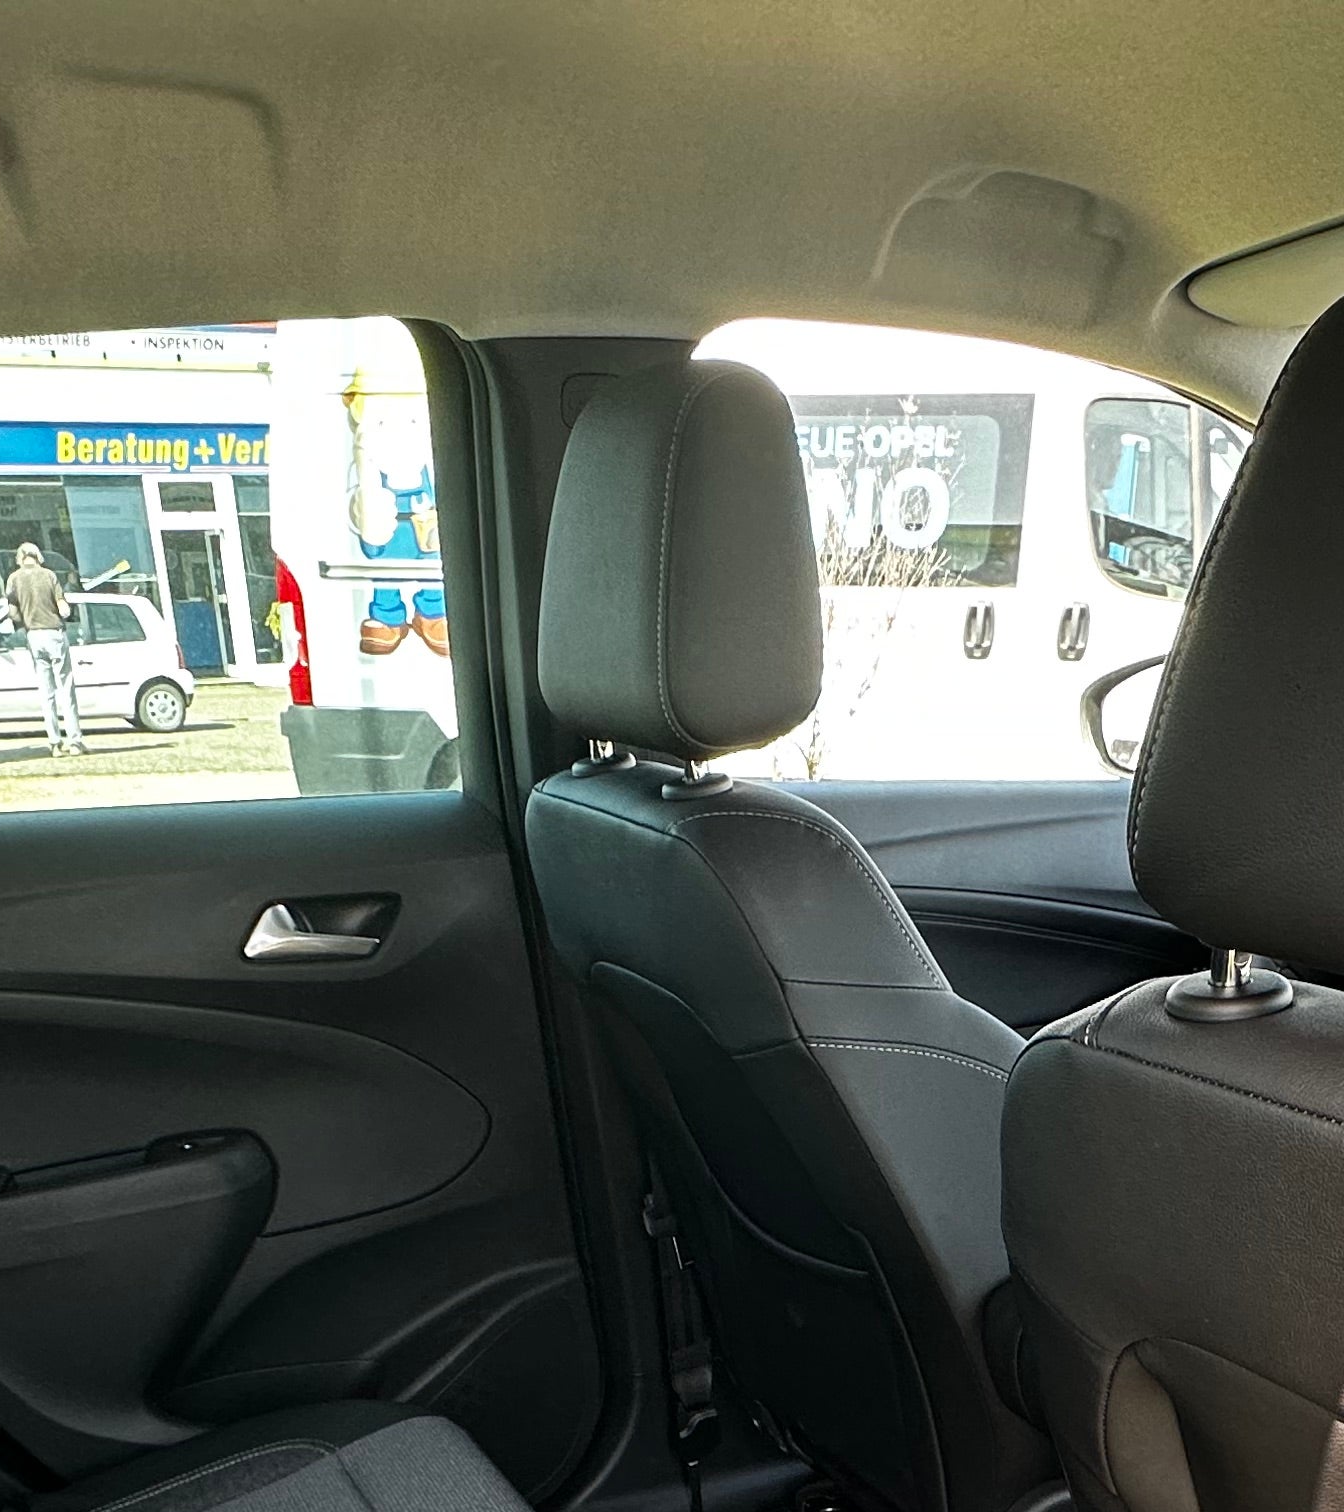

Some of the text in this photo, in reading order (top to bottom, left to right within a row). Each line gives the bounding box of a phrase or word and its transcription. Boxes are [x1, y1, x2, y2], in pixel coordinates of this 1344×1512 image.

[143, 337, 225, 350] INSPEKTION
[57, 431, 189, 471] Beratung
[864, 425, 955, 458] OPEL
